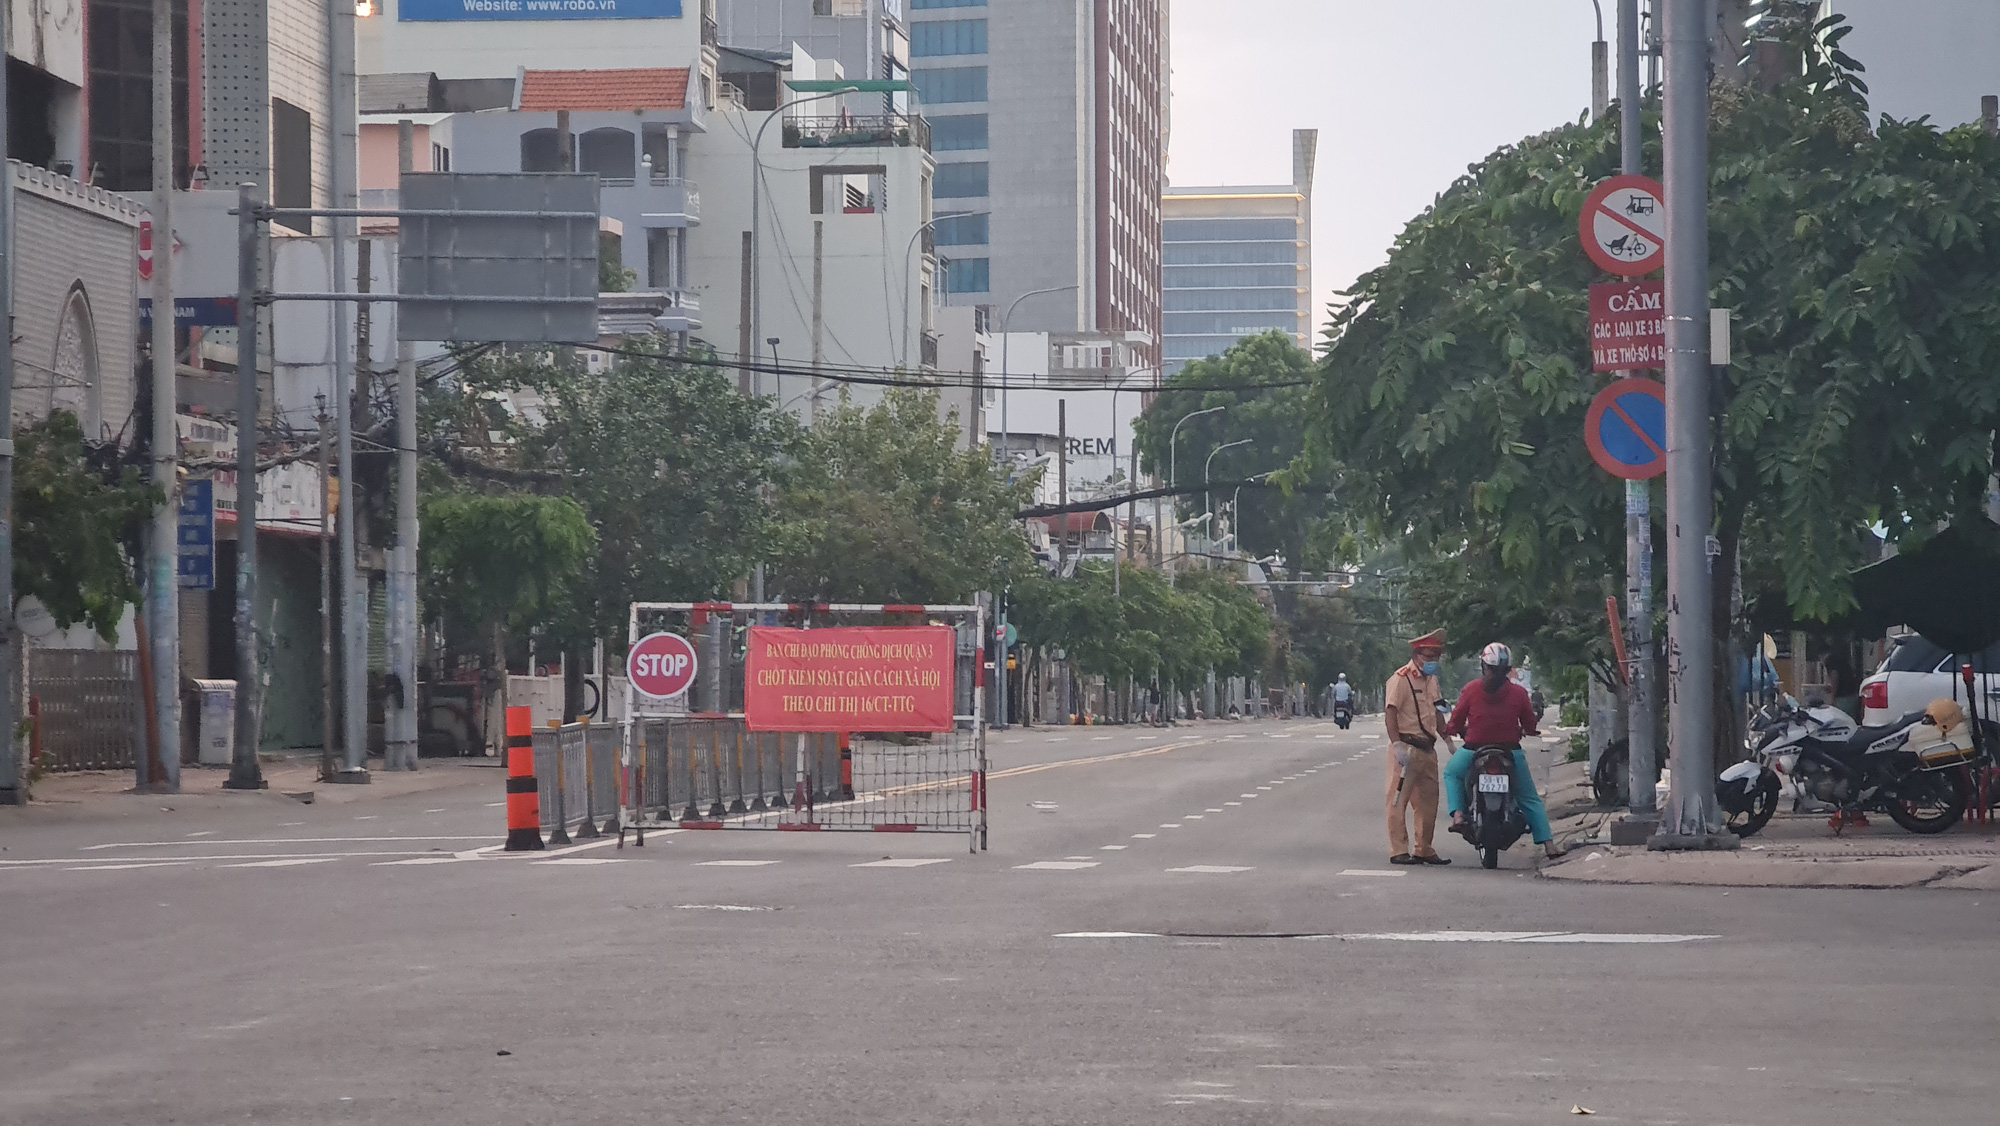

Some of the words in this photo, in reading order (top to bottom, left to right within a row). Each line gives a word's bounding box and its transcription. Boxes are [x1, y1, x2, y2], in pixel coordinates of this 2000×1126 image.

[463, 0, 522, 11] Website:
[527, 0, 616, 11] www.robo.vn
[1608, 285, 1662, 312] CẤM
[1594, 318, 1611, 338] CÁC
[1615, 321, 1633, 341] LOẠI
[1635, 320, 1646, 336] XE
[1648, 320, 1653, 335] 3
[1593, 345, 1605, 364] VÀ
[1606, 348, 1618, 364] XE
[1651, 347, 1656, 360] 4
[767, 643, 784, 658] BAN
[784, 640, 799, 658] CHỈ
[801, 643, 819, 661] ĐẠO
[820, 640, 849, 659] PHÒNG
[850, 641, 880, 660] CHỐNG
[882, 643, 902, 662] DỊCH
[903, 642, 927, 662] QUẬN
[928, 644, 934, 659] 3
[636, 654, 688, 677] STOP
[758, 664, 786, 686] CHỐT
[788, 663, 815, 686] KIỂM
[817, 666, 844, 686] SOÁT
[846, 667, 871, 687] GIÃN
[874, 665, 902, 686] CÁCH
[904, 666, 919, 686] XÃ
[922, 668, 941, 690] HỘI
[783, 695, 813, 712] THEO
[815, 692, 835, 712] CHỈ
[838, 696, 858, 716] THỊ
[861, 695, 915, 713] 16/CT-TTG
